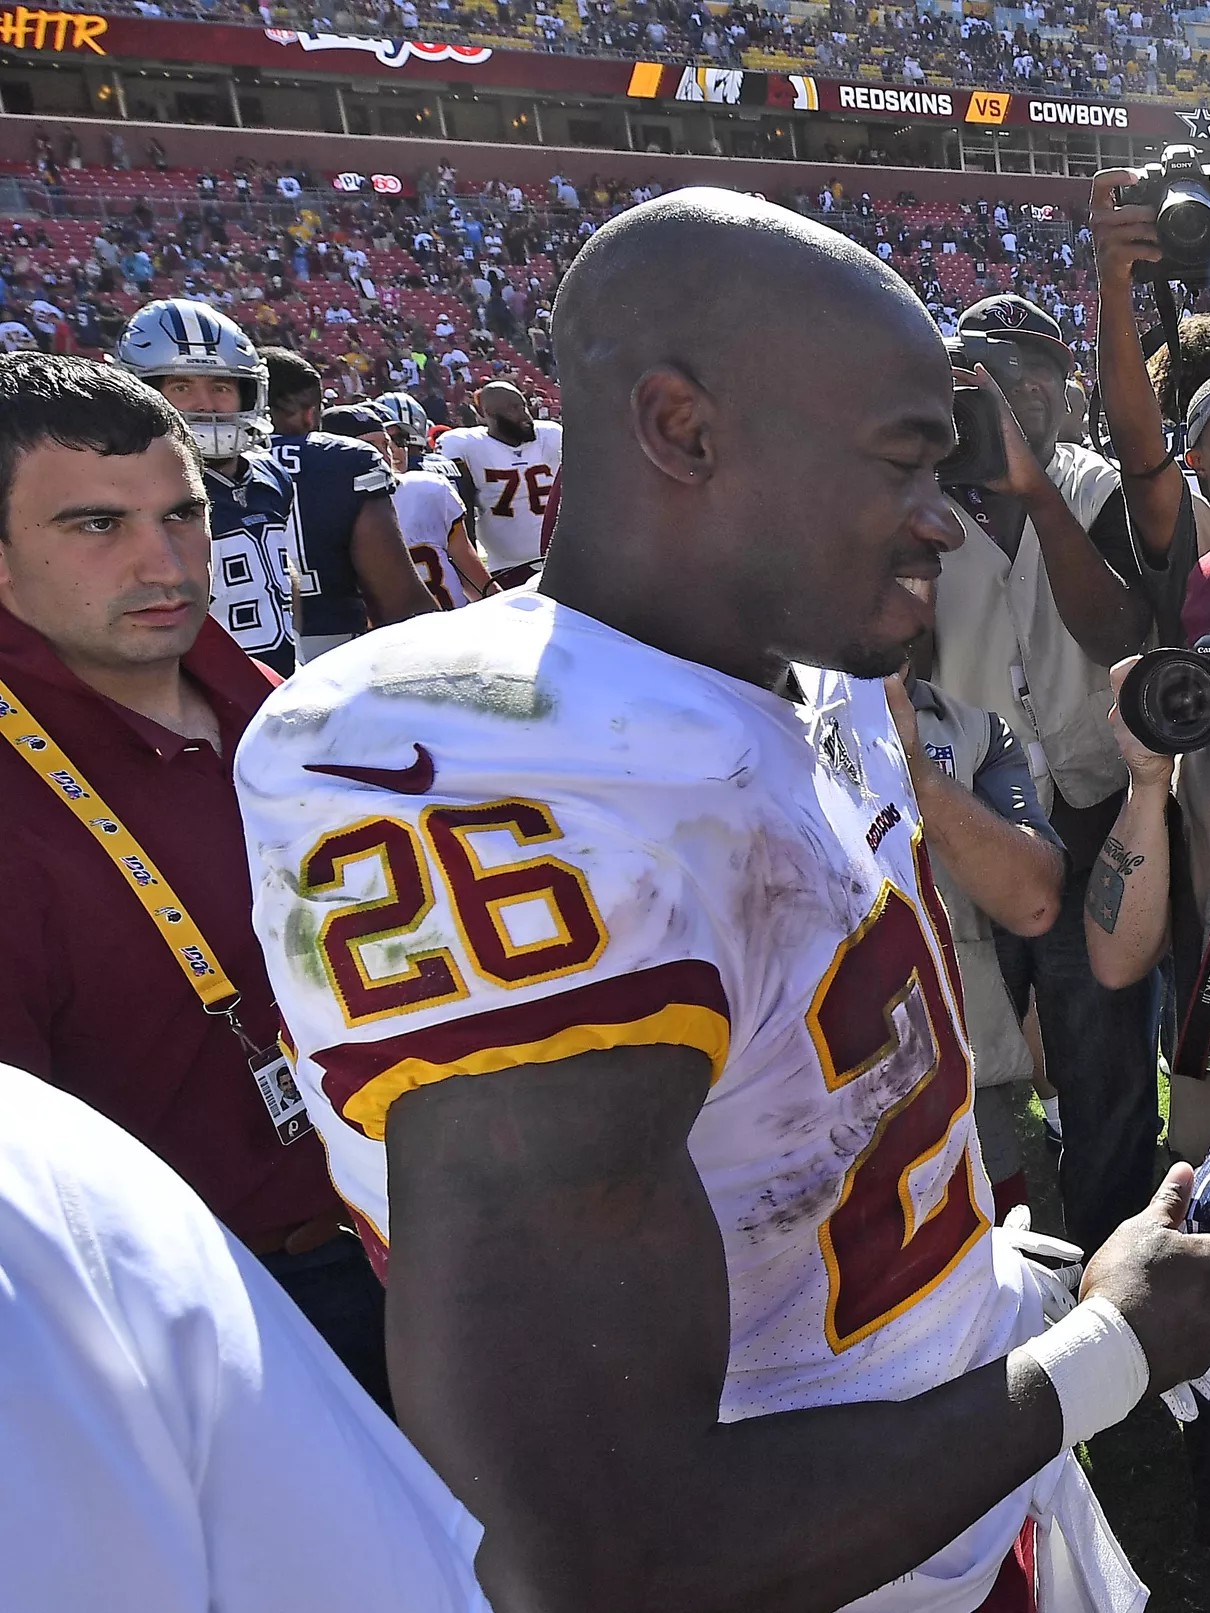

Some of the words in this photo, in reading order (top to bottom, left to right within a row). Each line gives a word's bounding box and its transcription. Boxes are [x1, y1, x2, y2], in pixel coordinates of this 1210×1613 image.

[0, 6, 107, 56] HTTR
[839, 86, 952, 116] REDSKINS
[975, 98, 1001, 117] VS
[1029, 101, 1128, 128] COWBOYS
[484, 464, 555, 518] 76
[301, 799, 610, 1029] 26
[805, 820, 992, 1355] 2
